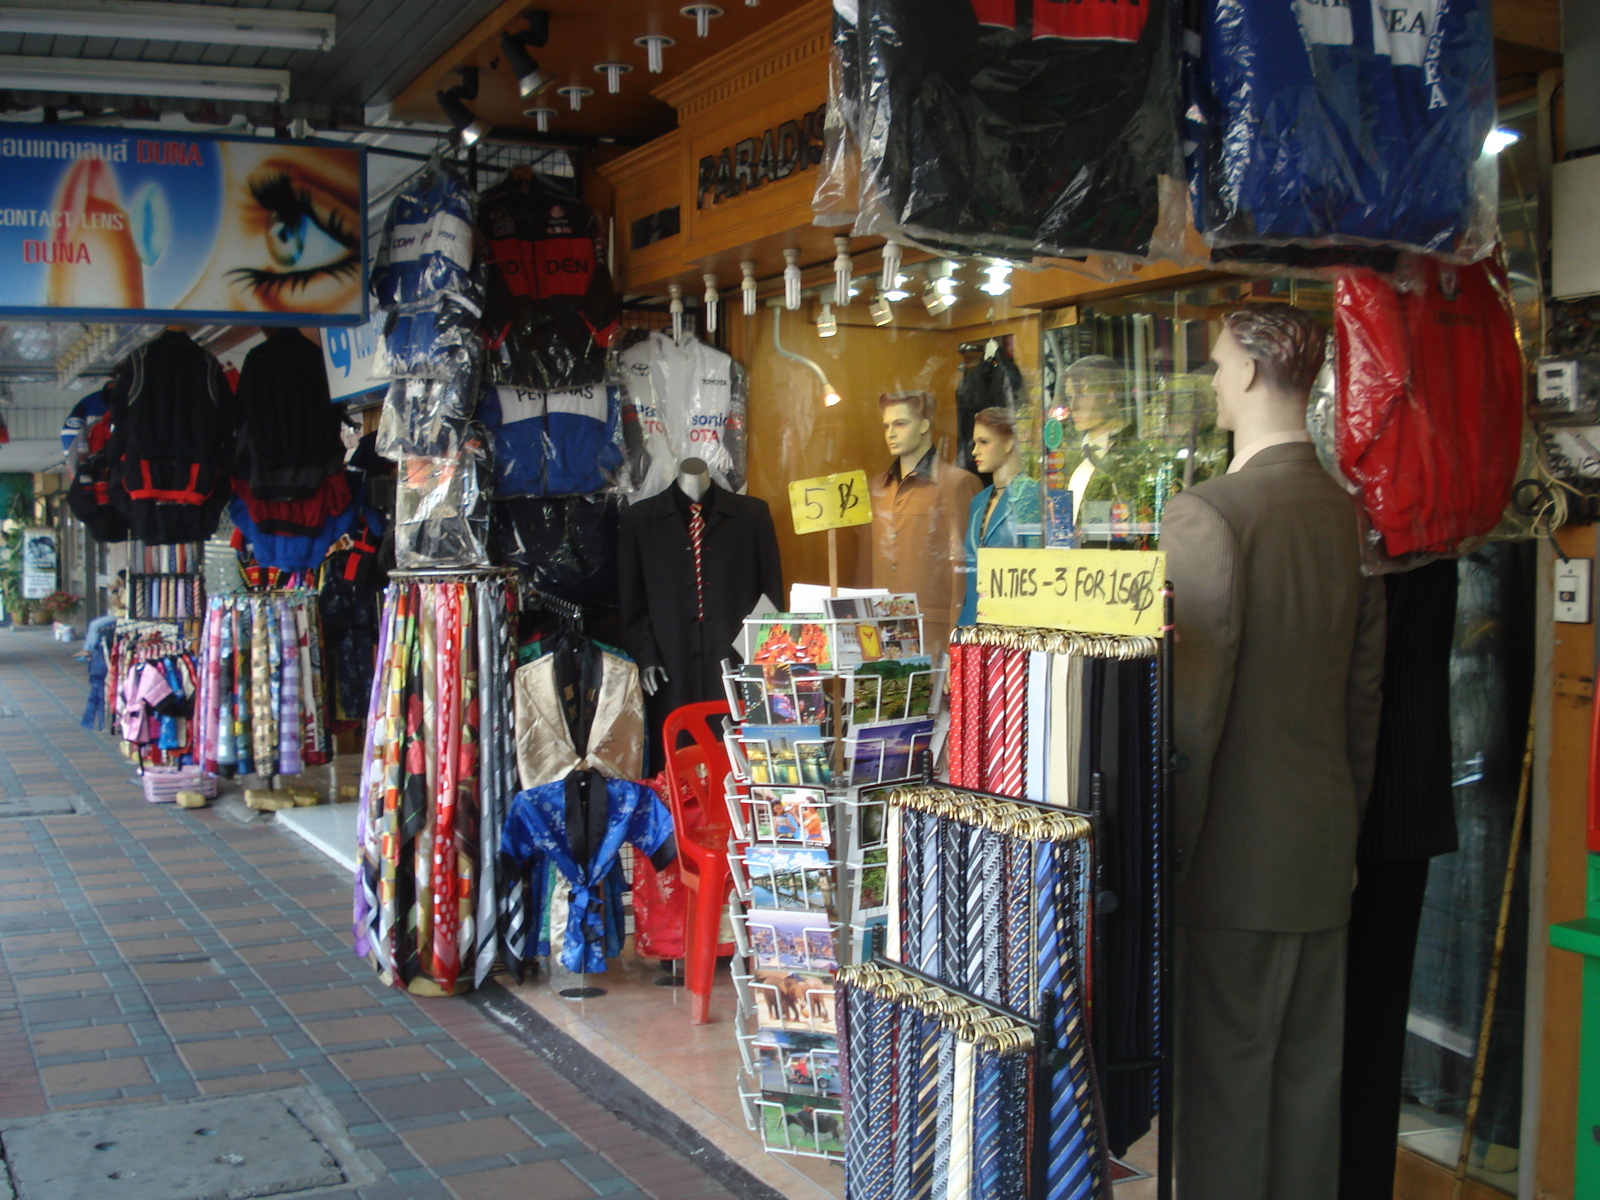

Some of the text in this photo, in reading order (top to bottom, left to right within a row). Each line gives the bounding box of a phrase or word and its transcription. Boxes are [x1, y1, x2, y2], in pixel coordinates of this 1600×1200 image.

[0, 138, 129, 162] อนแทคเลนส์
[137, 140, 203, 166] DUNA
[82, 212, 124, 231] LENS
[23, 239, 91, 264] DUNA
[702, 378, 728, 387] TOYOTA
[804, 487, 826, 520] 5
[1074, 566, 1106, 602] FOR
